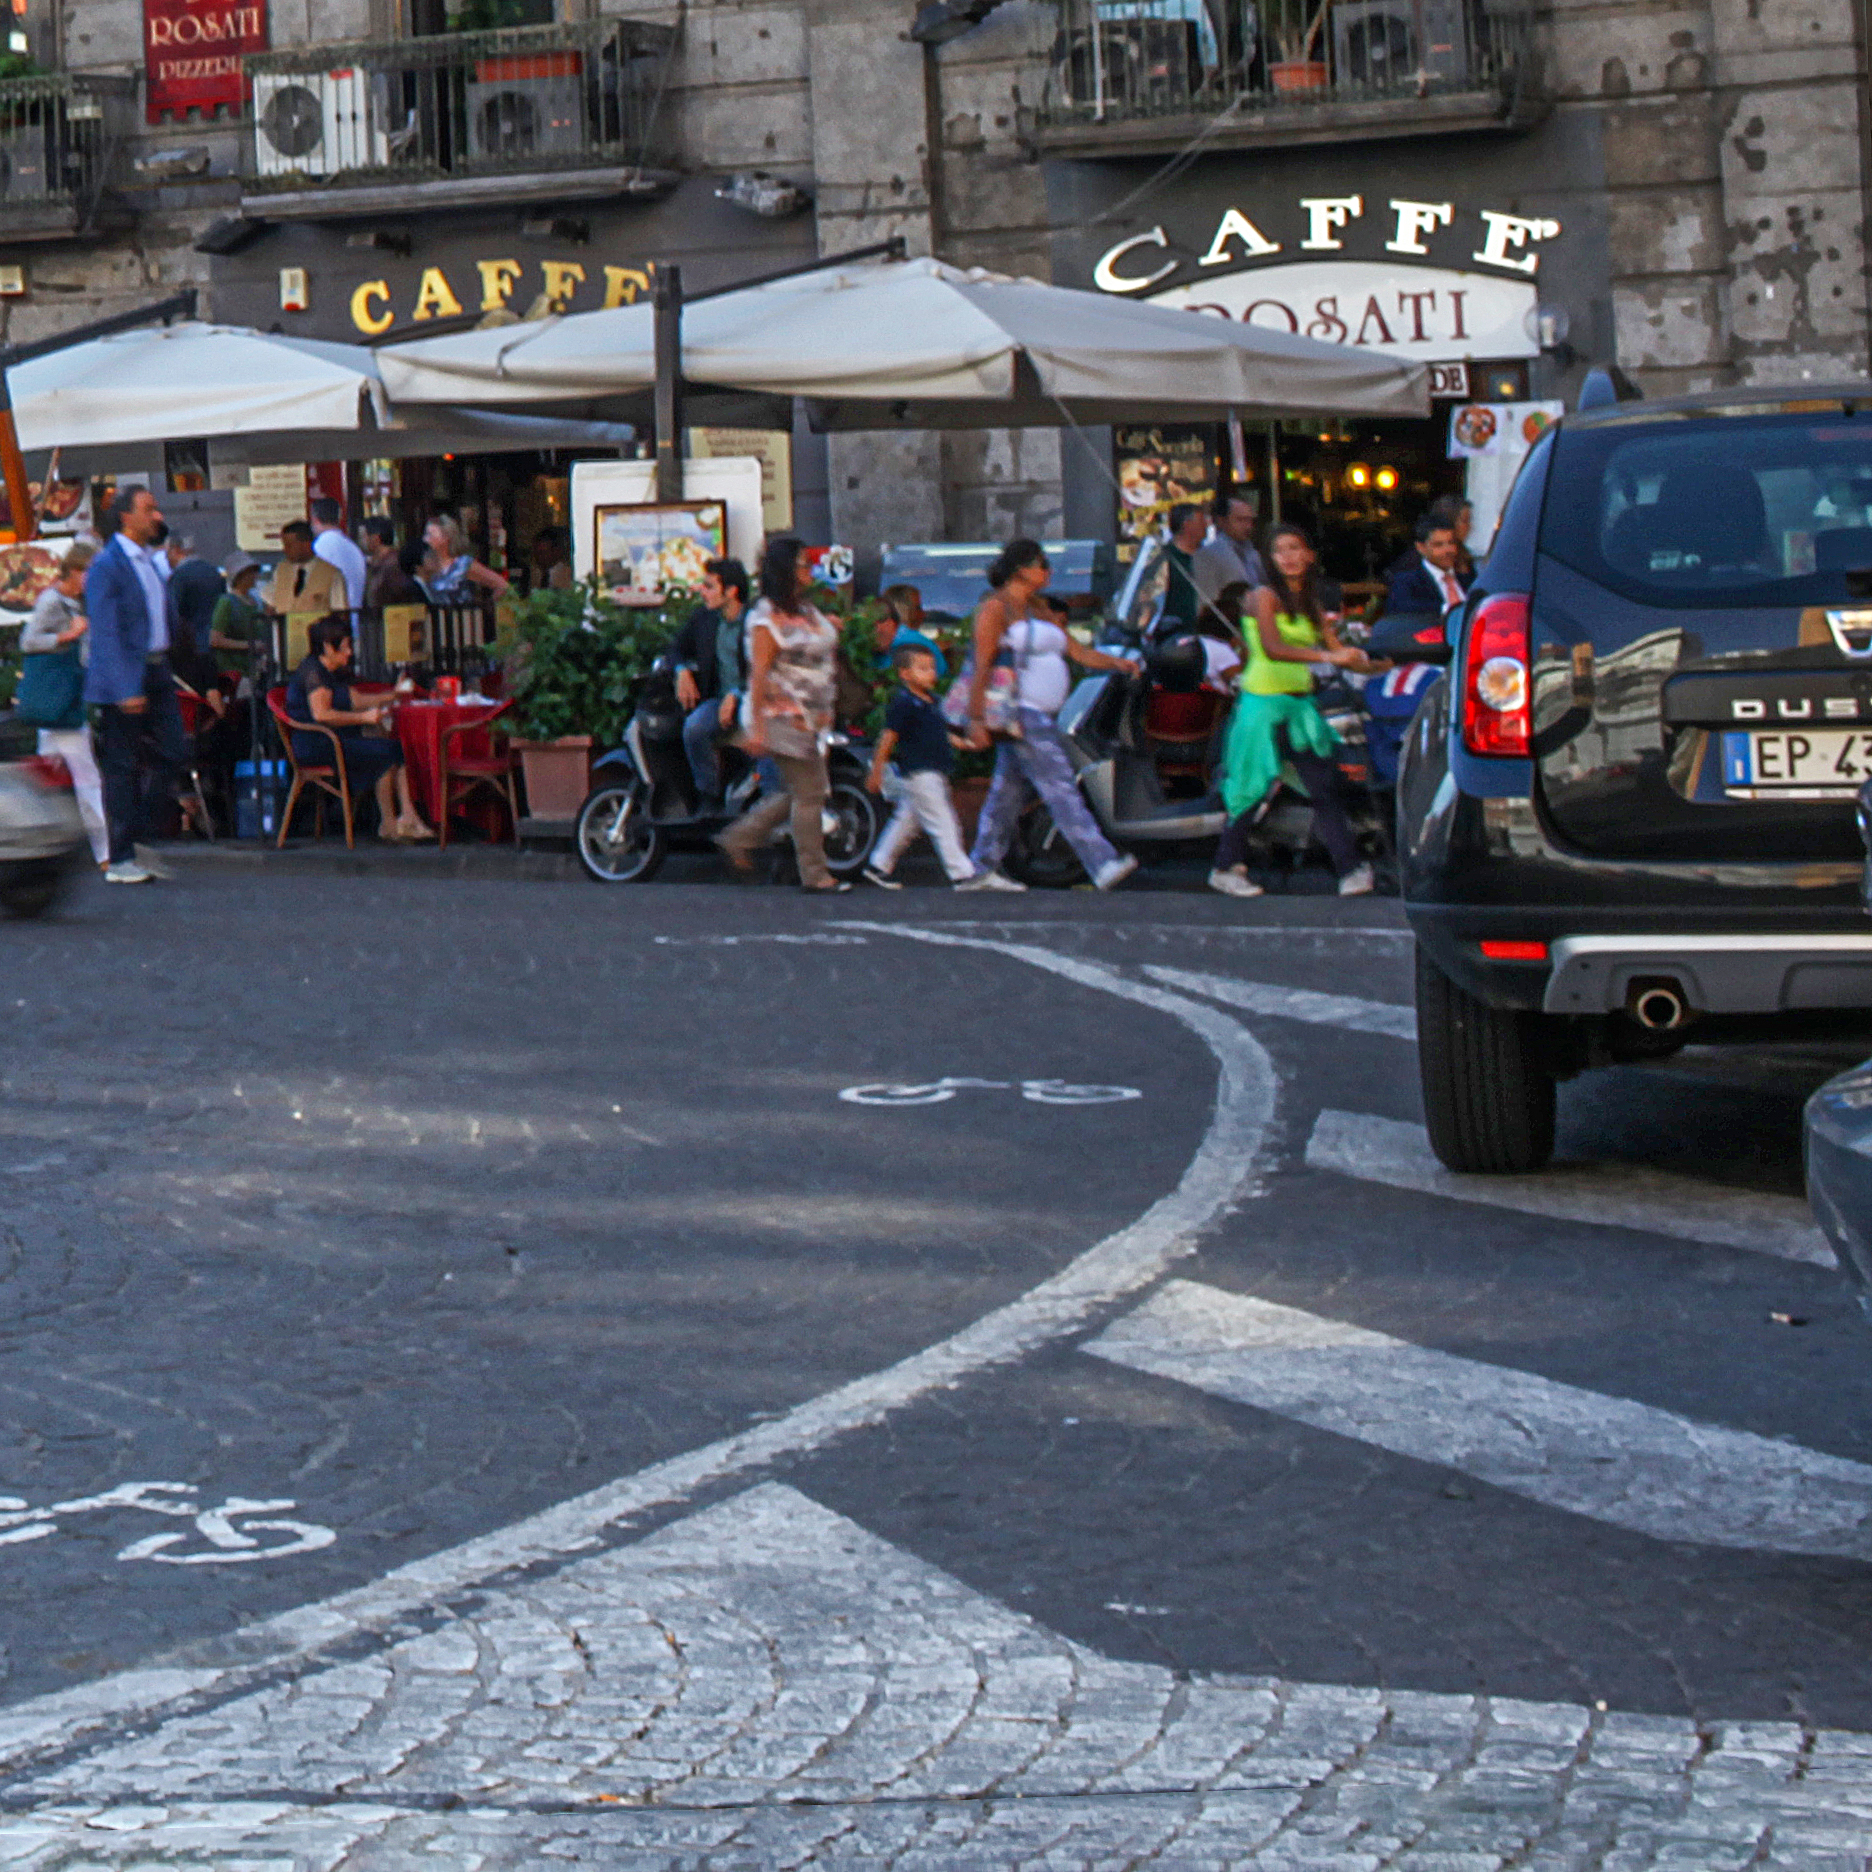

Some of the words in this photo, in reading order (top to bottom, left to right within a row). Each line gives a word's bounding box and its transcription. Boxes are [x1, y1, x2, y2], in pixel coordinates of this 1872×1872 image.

[149, 6, 260, 46] ROSATI
[158, 54, 238, 80] PIZZERI
[1757, 735, 1811, 779] EP
